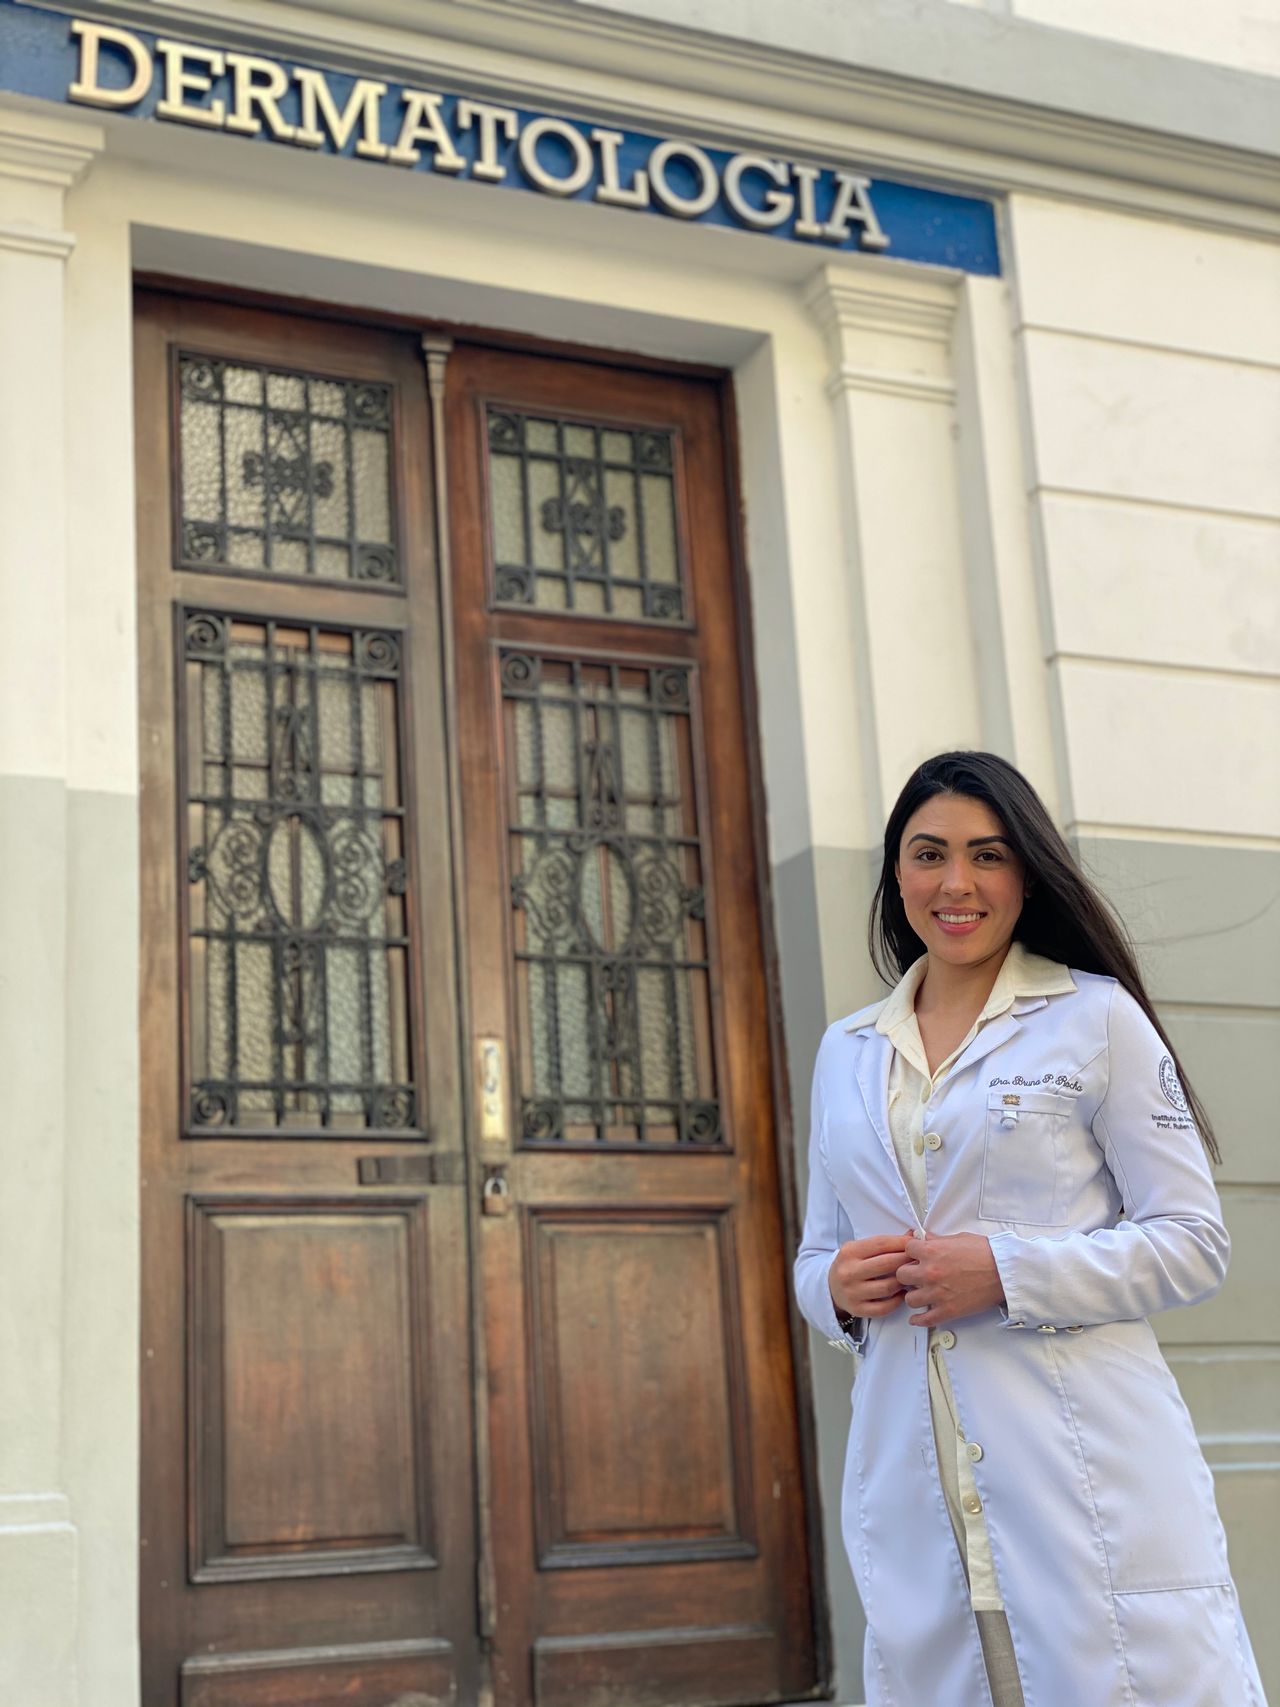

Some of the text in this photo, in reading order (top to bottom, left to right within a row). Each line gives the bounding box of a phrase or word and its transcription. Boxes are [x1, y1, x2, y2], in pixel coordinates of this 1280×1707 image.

[68, 20, 892, 251] DERMATOLOGIA
[989, 1078, 1010, 1088] Dra.
[1042, 1074, 1054, 1084] P.
[1055, 1075, 1083, 1092] Rocha
[1151, 1114, 1176, 1122] Instituto
